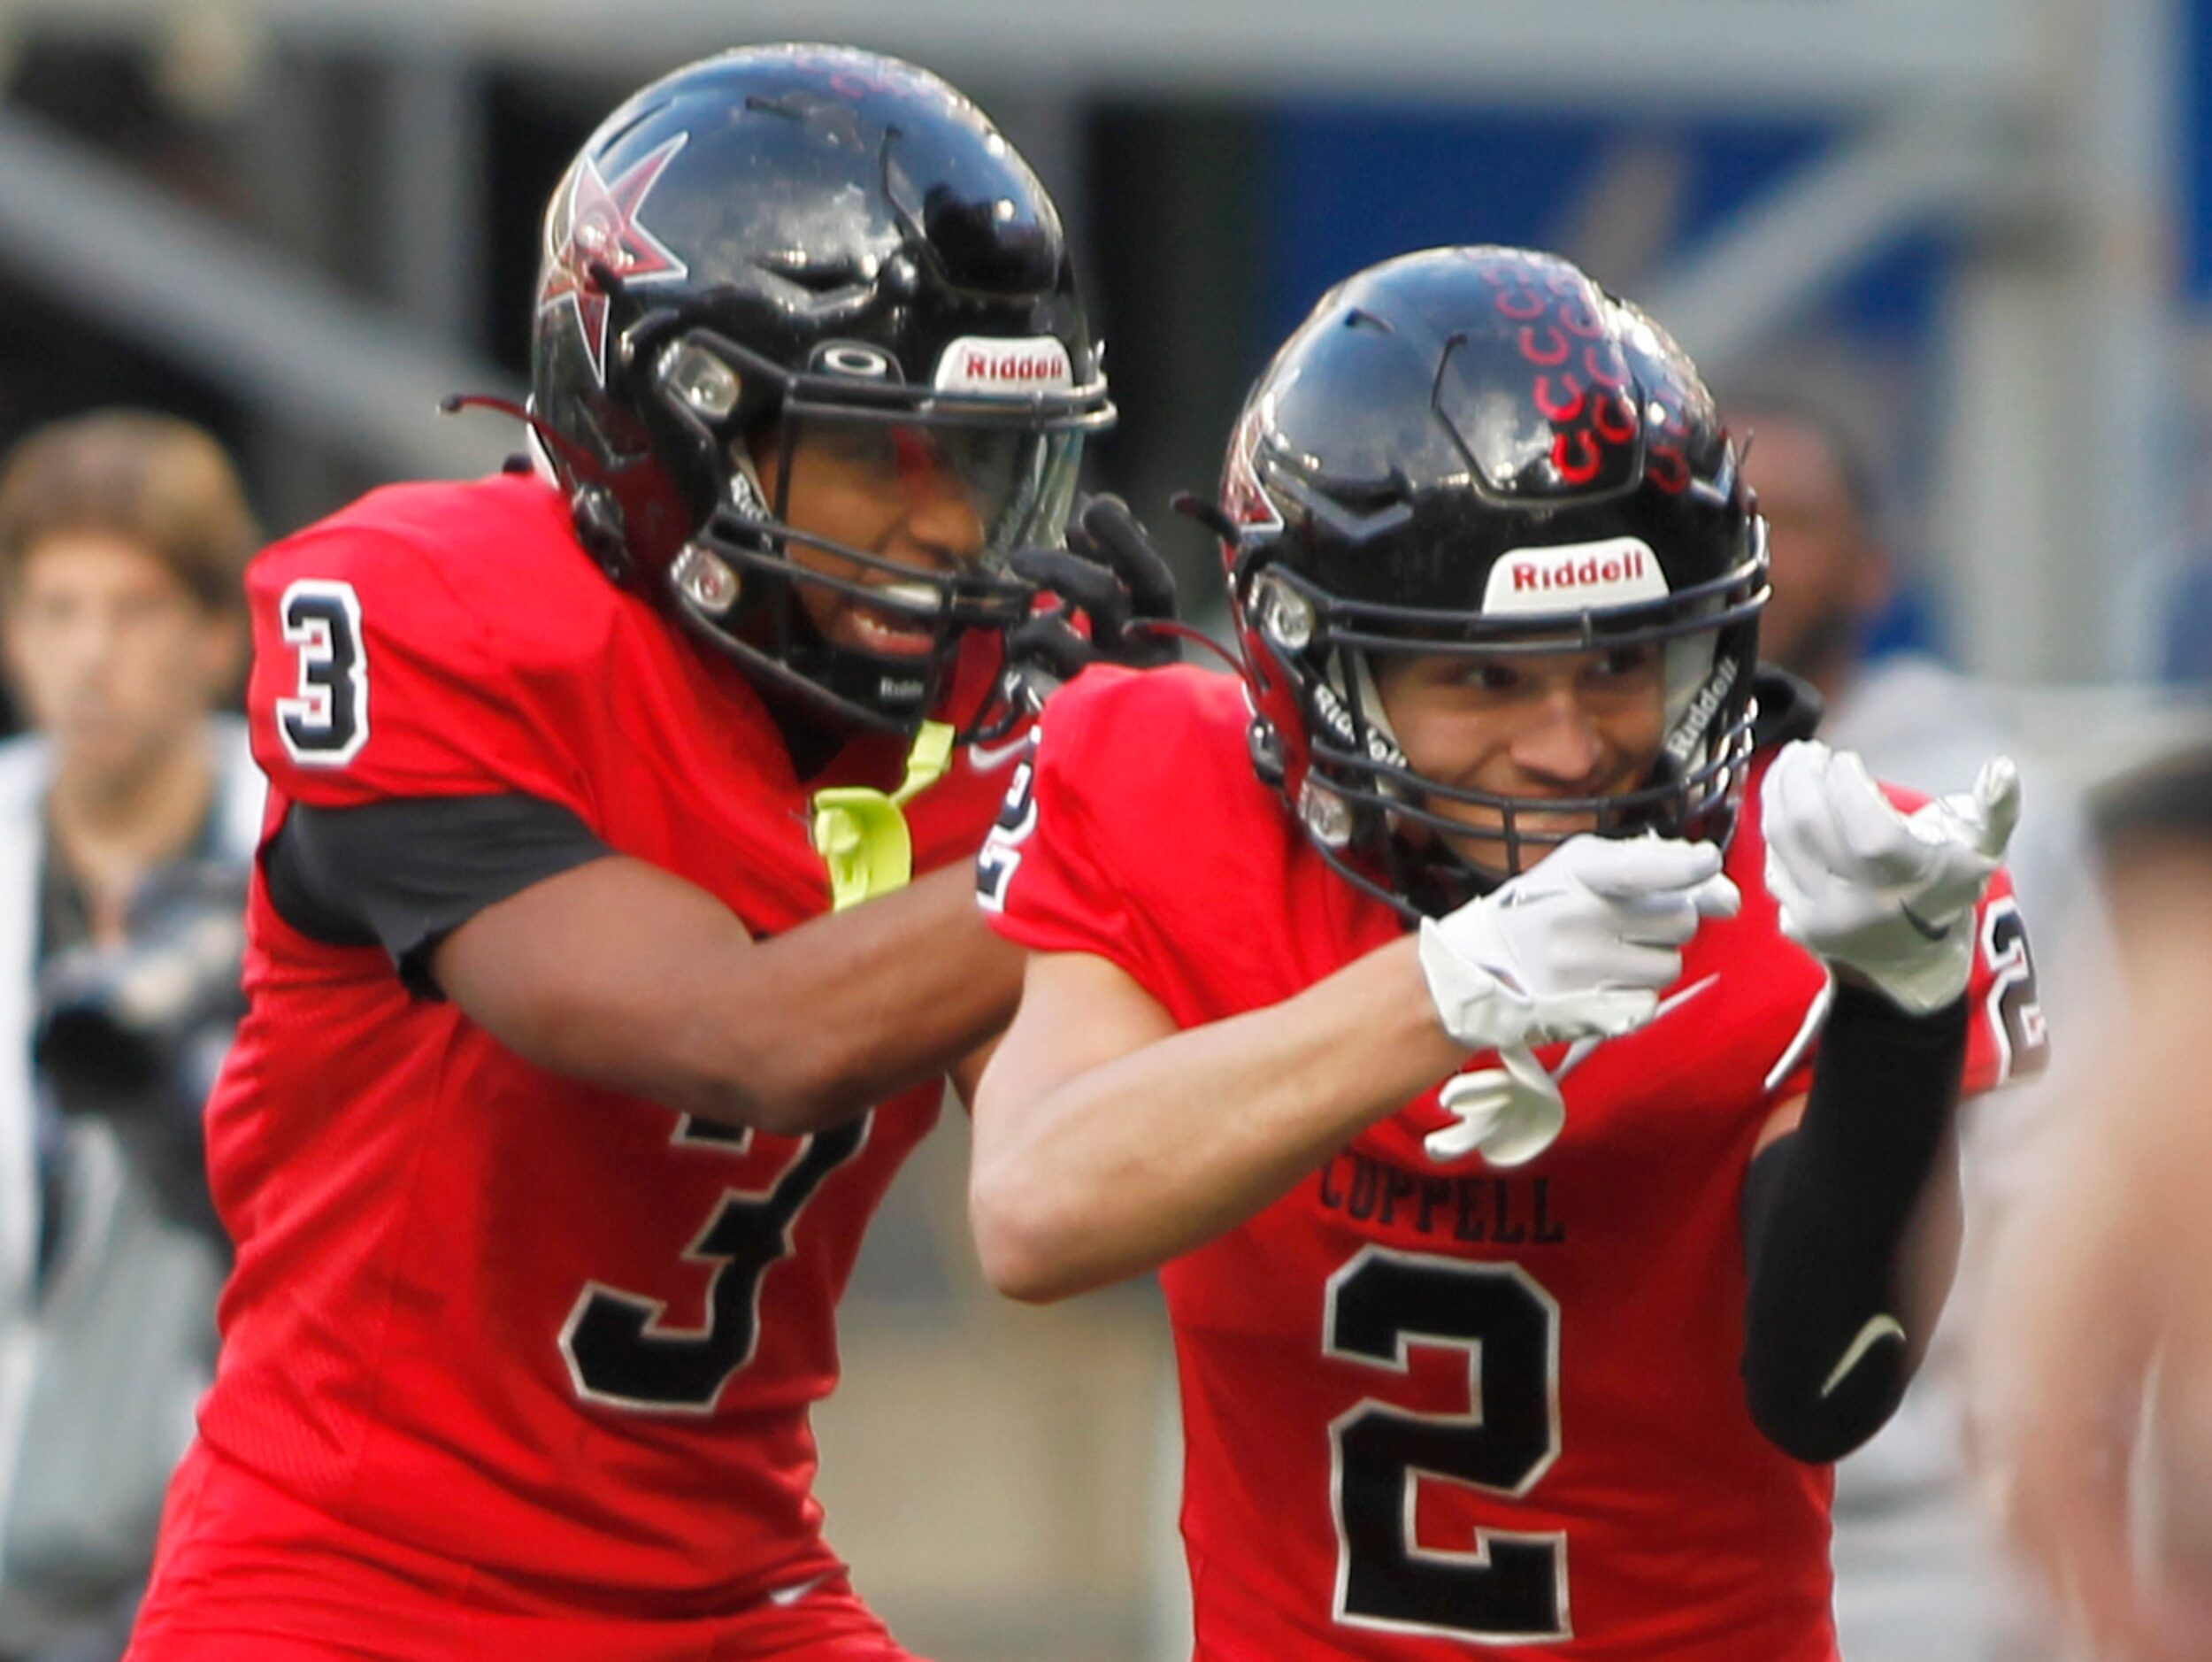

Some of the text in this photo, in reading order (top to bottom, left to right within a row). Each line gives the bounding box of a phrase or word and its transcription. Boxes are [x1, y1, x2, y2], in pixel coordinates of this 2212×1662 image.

[1512, 549, 1644, 591] Riddell
[275, 579, 368, 765] 3
[1981, 894, 2051, 1086] 2
[1321, 1242, 1573, 1646] 2
